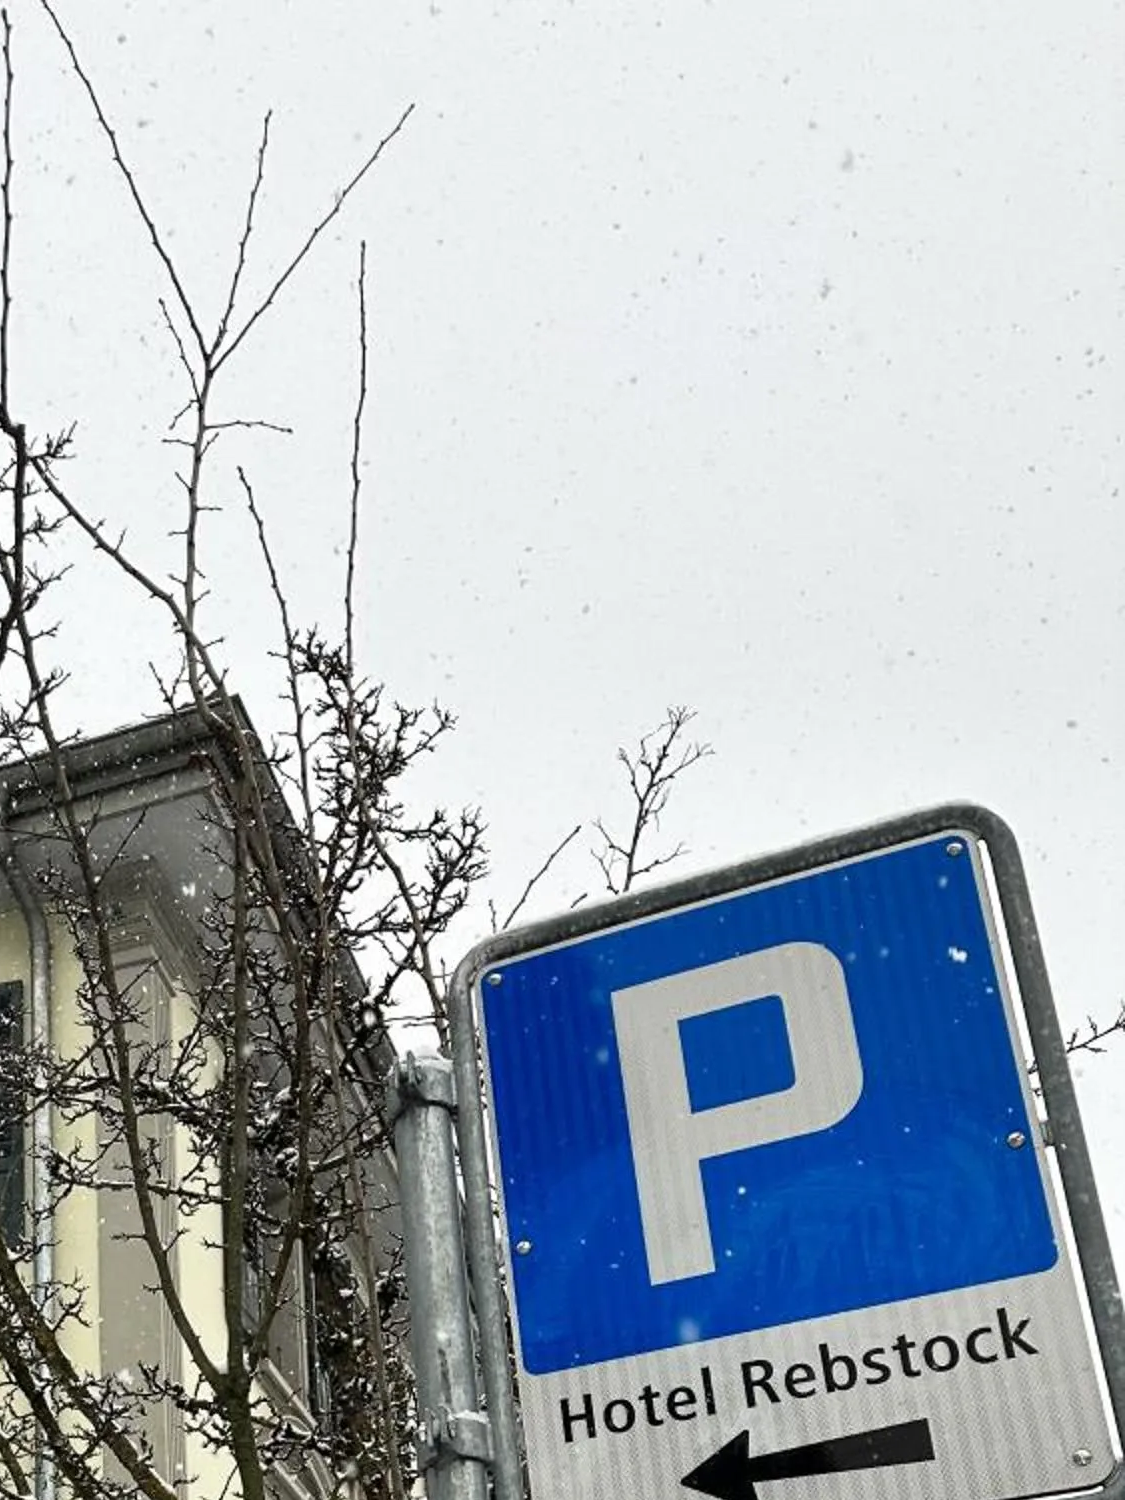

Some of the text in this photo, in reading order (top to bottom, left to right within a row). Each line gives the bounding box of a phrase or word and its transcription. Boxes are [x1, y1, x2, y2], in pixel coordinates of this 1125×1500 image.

[611, 941, 864, 1286] P
[560, 1307, 1038, 1443] Hotel Rebstock
